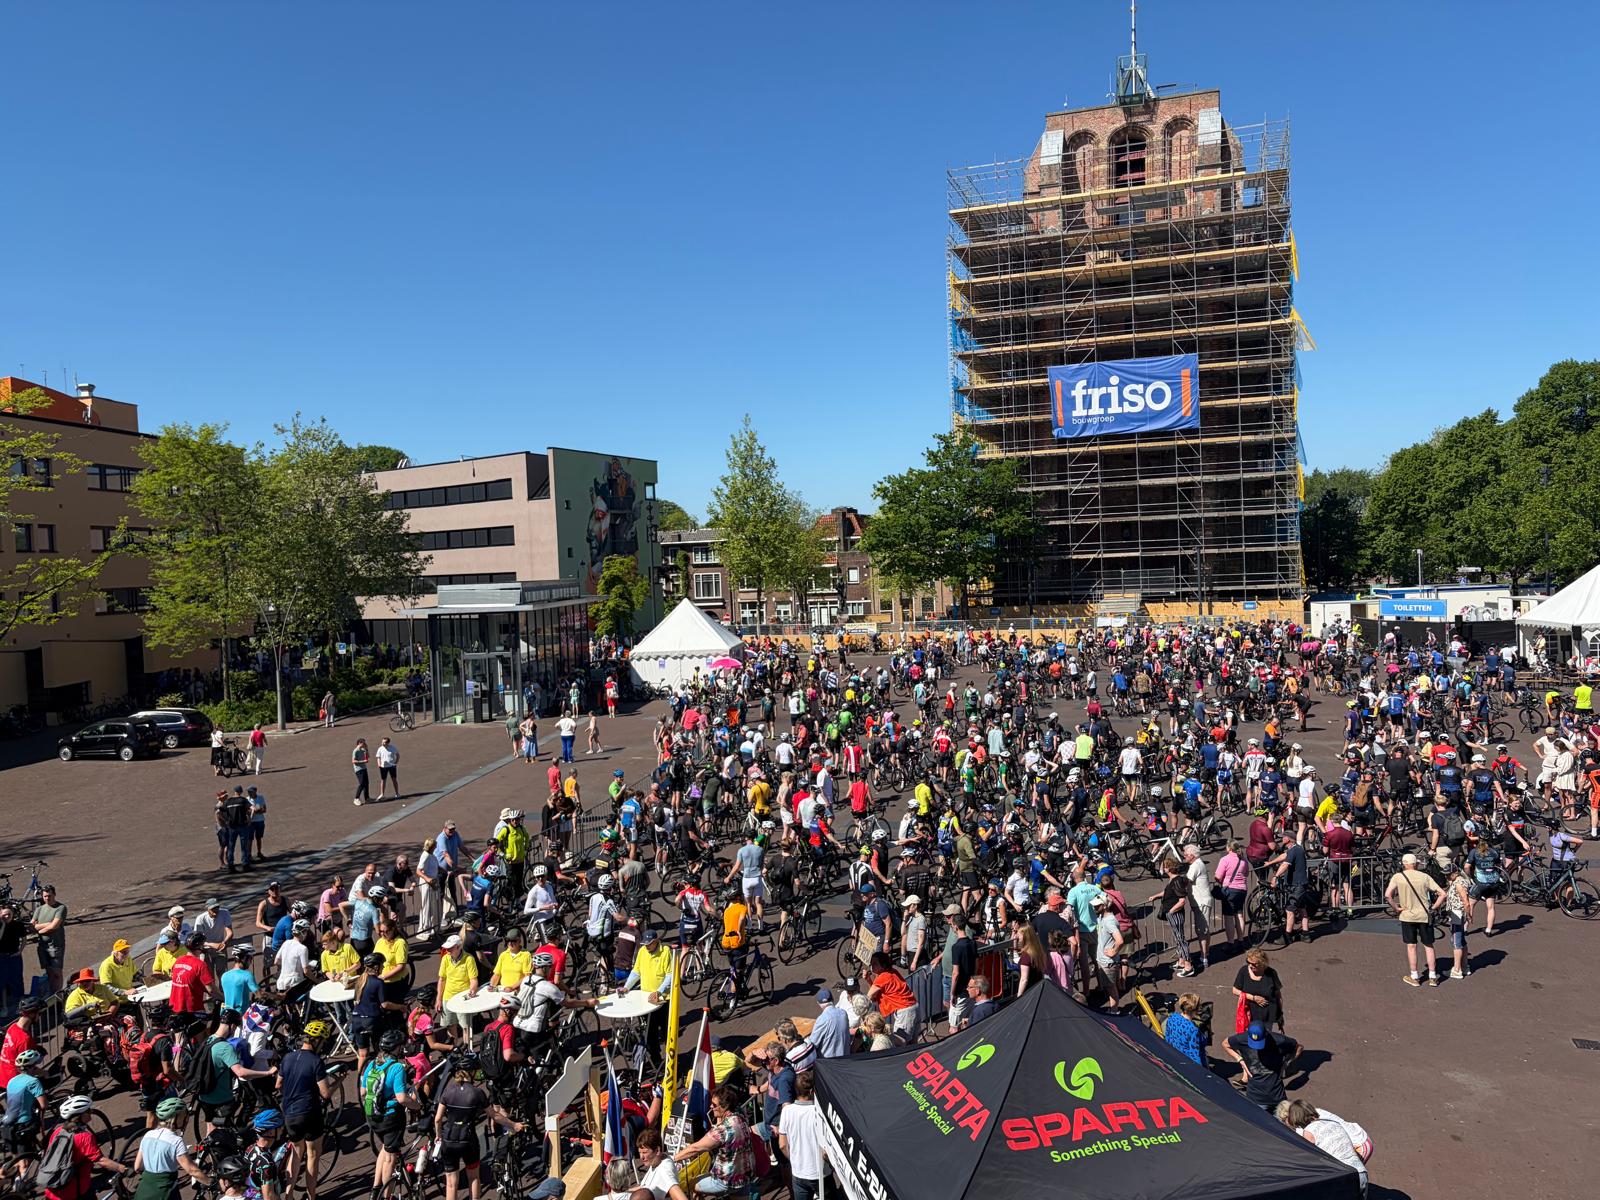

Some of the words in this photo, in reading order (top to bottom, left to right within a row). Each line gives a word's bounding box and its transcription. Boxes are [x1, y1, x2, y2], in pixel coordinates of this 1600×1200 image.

[1071, 375, 1172, 417] friso
[1072, 414, 1115, 425] bouwgroep
[1393, 604, 1433, 612] TOILETTEN
[902, 1080, 930, 1111] Something
[926, 1105, 956, 1136] Special
[905, 1051, 991, 1142] SPARTA
[1001, 1096, 1209, 1151] SPARTA
[1050, 1139, 1132, 1164] Something
[1130, 1131, 1182, 1149] Special
